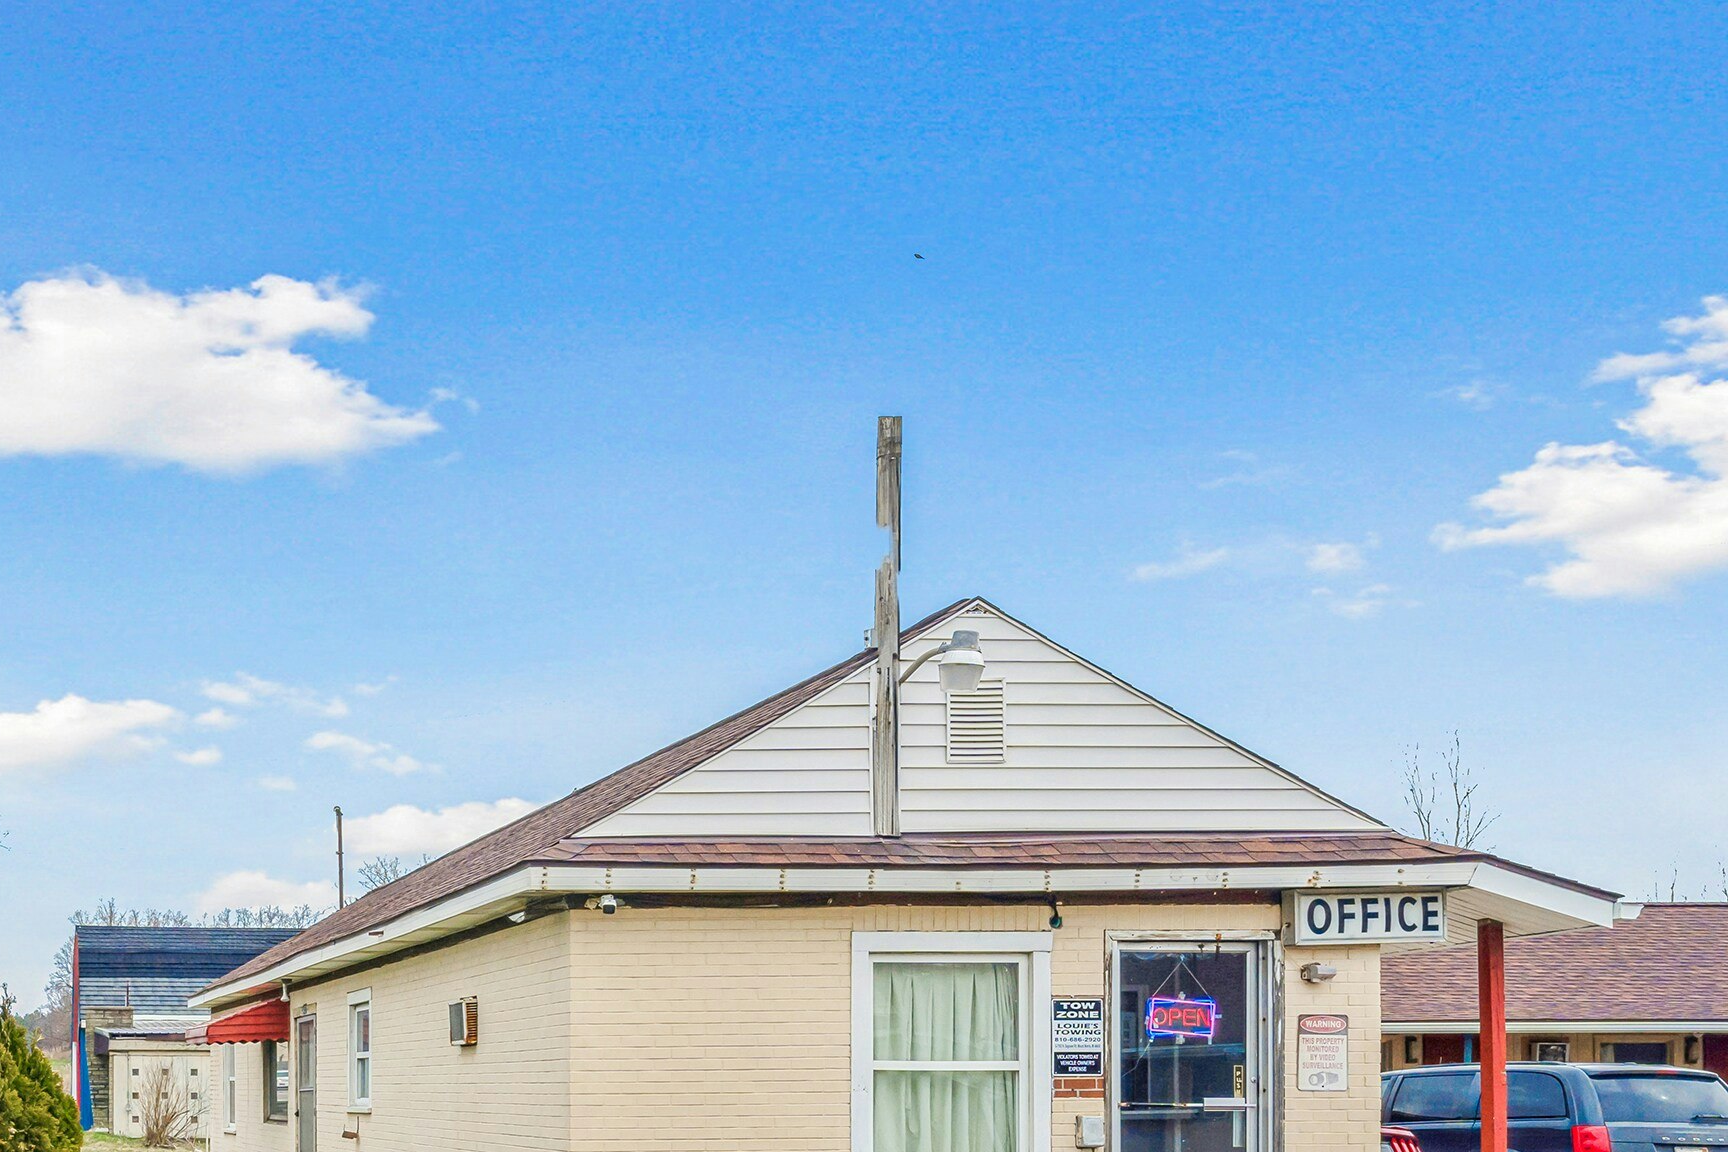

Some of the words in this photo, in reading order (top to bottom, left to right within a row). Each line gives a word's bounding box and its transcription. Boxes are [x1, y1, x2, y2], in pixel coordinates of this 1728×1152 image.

[1306, 896, 1440, 935] OFFICE
[1059, 1002, 1096, 1010] TOW
[1055, 1010, 1100, 1019] ZONE
[1152, 1007, 1212, 1027] OPEN
[1305, 1020, 1342, 1028] WARNING
[1302, 1037, 1315, 1045] THIS
[1315, 1037, 1345, 1045] PROPERTY
[1306, 1045, 1340, 1053] MONITORED
[1309, 1053, 1318, 1061] BY
[1319, 1053, 1336, 1061] VIDEO
[1302, 1062, 1344, 1070] SURVEILLANCE
